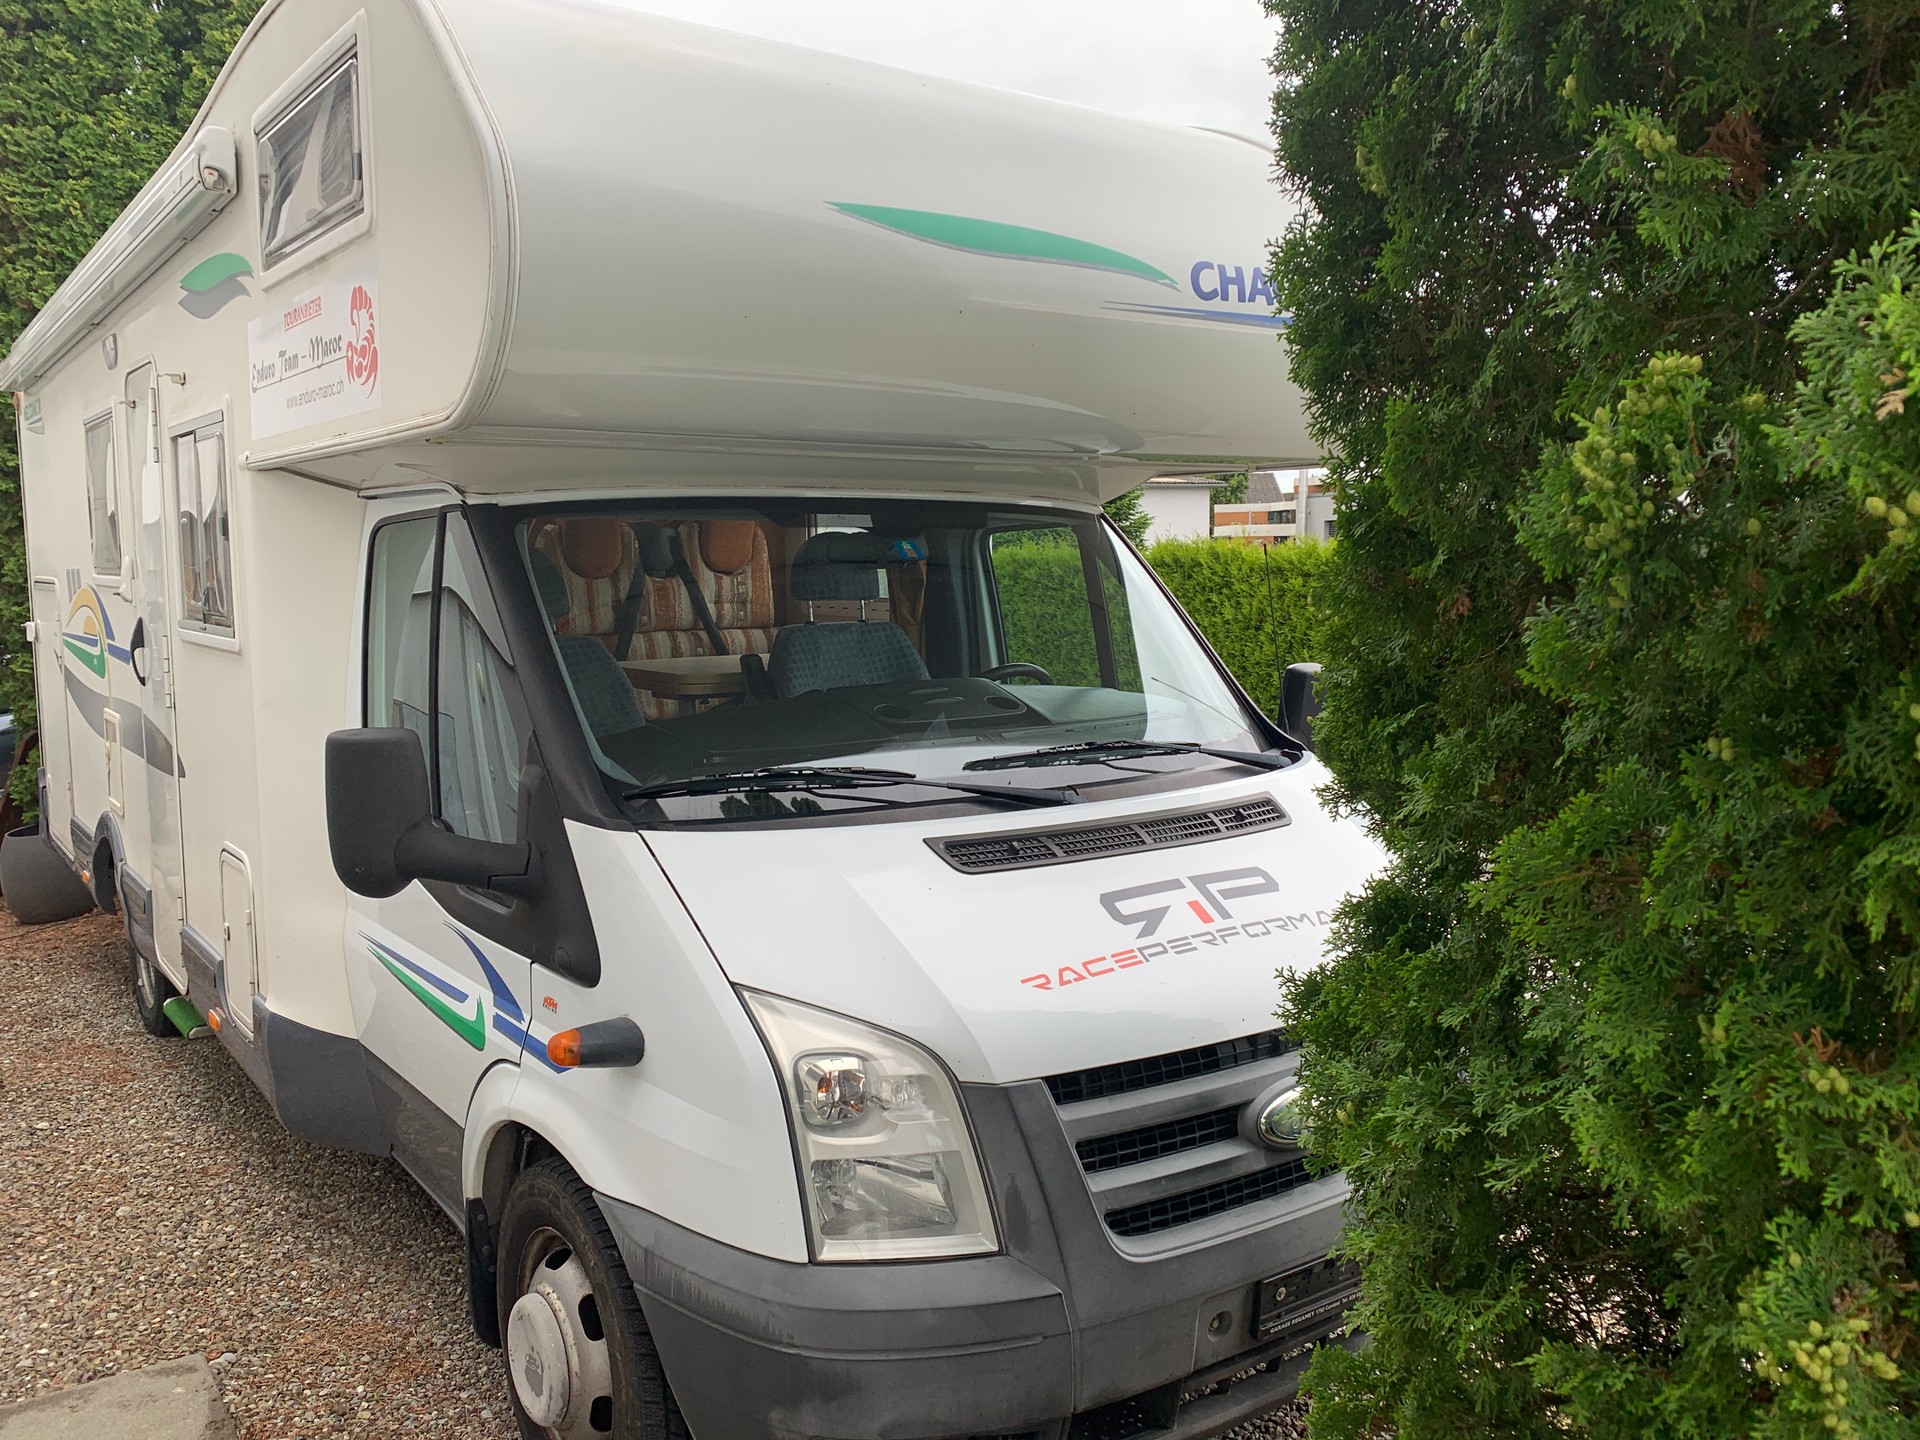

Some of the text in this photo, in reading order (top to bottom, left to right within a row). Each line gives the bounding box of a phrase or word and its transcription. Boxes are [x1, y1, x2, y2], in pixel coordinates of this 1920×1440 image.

[1190, 260, 1281, 306] CHA
[284, 296, 322, 328] TOURANBIETER
[252, 360, 276, 389] Enduro
[278, 349, 299, 381] Team
[309, 334, 342, 366] Maroc
[286, 377, 344, 409] www.enduro-maroc.ch
[1270, 1320, 1291, 1334] GARAGE
[1291, 1311, 1316, 1325] REGAMEY
